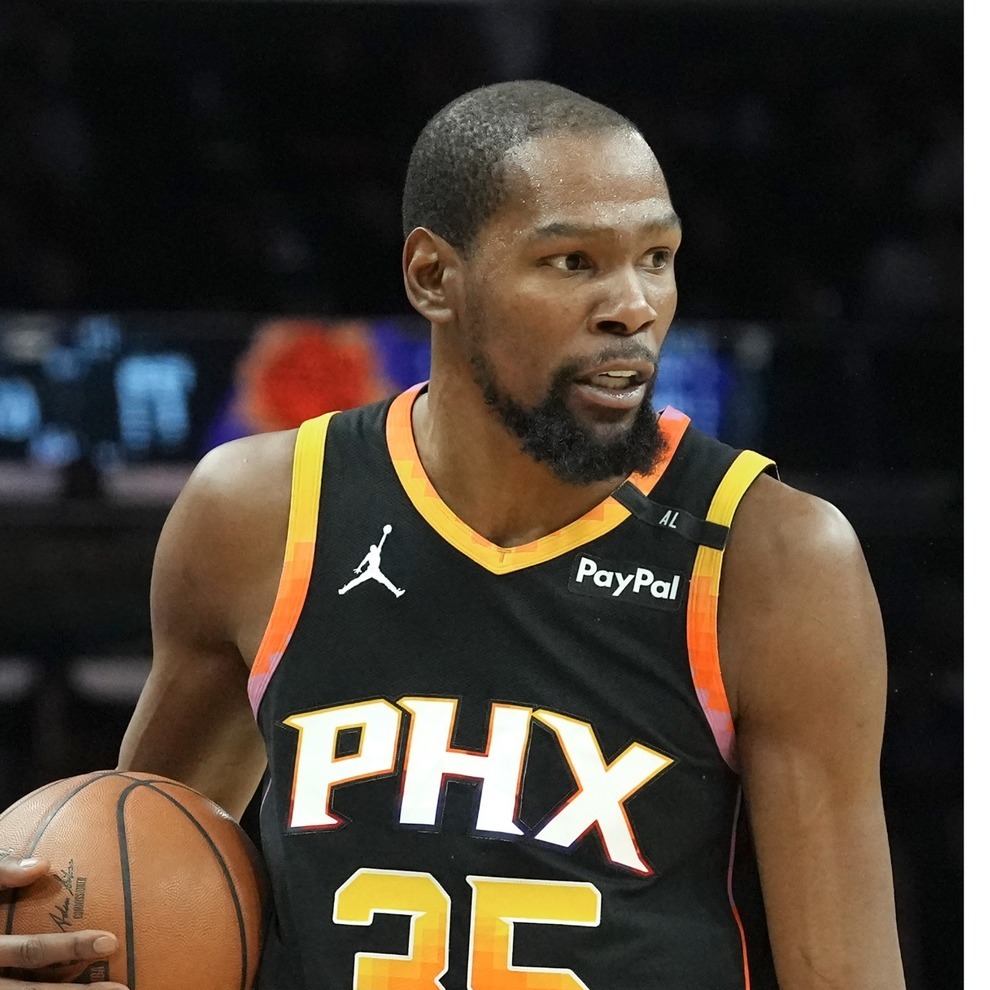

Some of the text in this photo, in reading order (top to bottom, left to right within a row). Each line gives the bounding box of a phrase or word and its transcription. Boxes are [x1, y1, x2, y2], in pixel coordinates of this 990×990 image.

[658, 509, 680, 529] AL
[575, 556, 681, 601] PayPal
[282, 696, 675, 877] PHX
